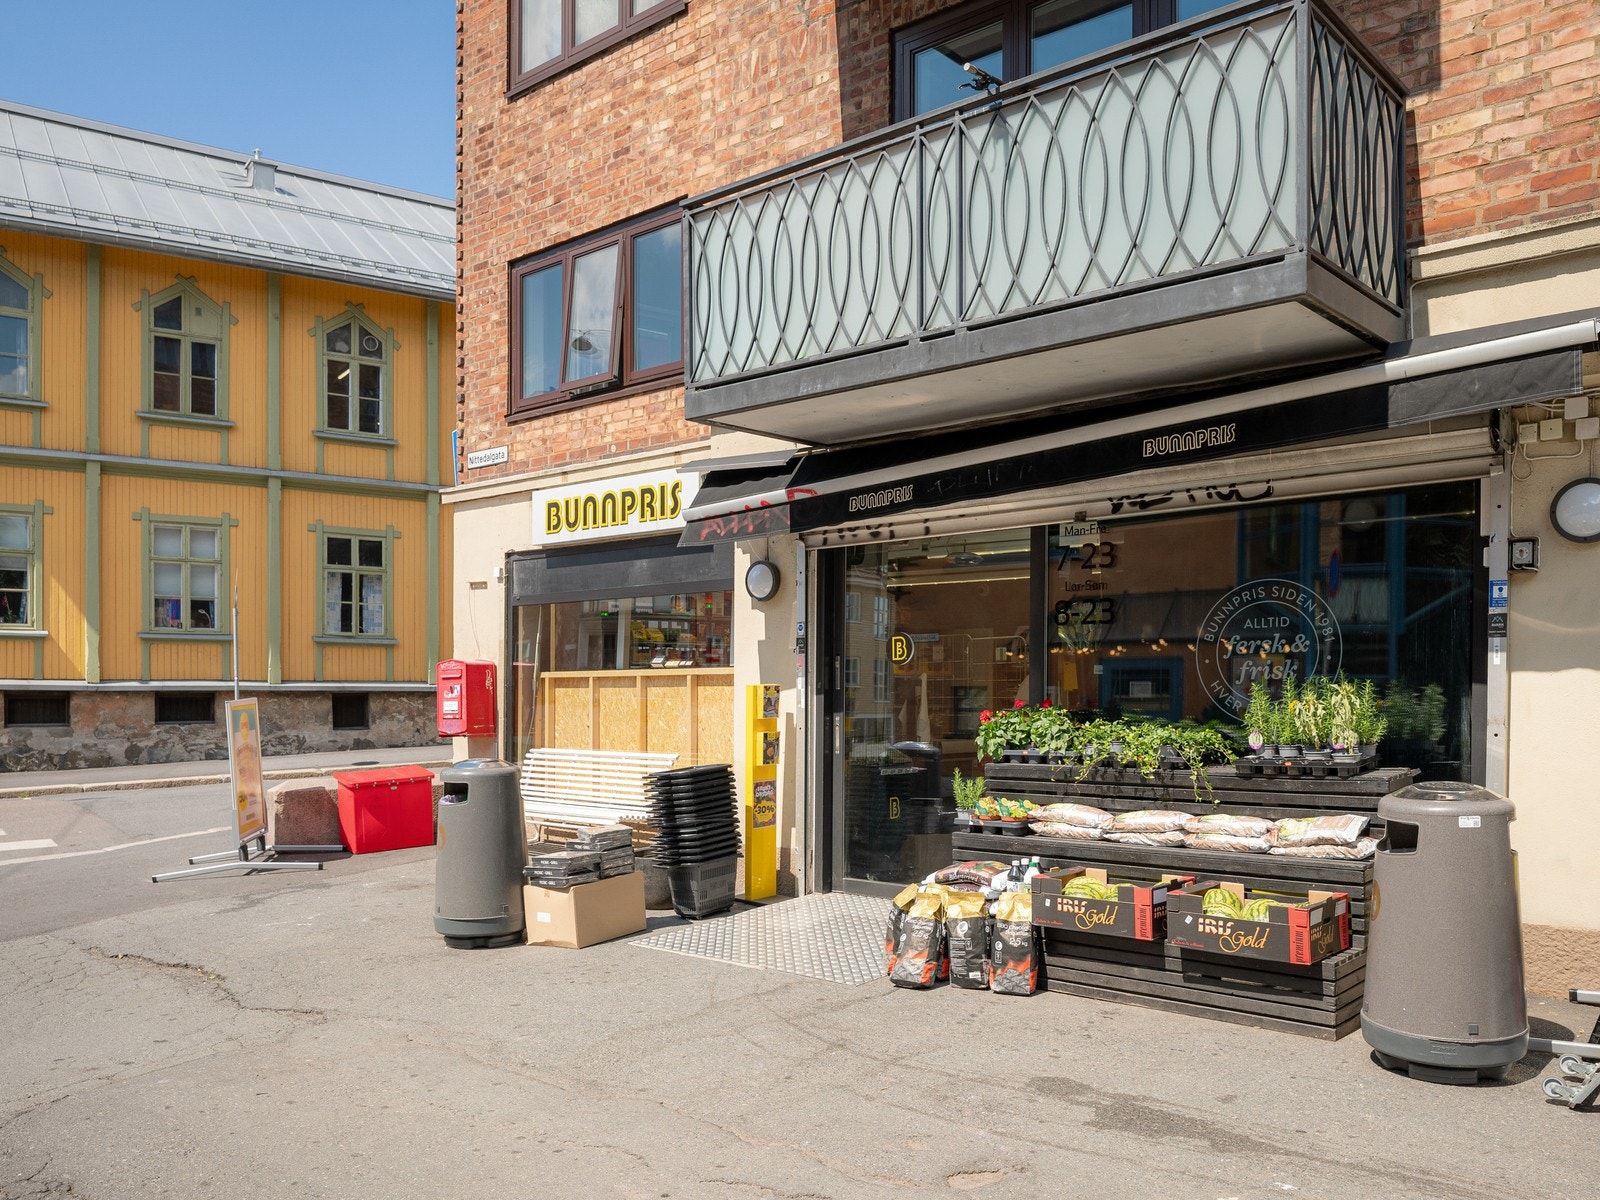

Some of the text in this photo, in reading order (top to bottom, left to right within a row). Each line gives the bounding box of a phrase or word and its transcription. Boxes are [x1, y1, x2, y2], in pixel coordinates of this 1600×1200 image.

[1142, 423, 1236, 457] BUNNPRIS
[469, 451, 505, 465] Nittedalgata
[545, 479, 682, 534] BUNNPRIS
[849, 484, 913, 512] BUNNPRIS
[1055, 541, 1116, 571] 7-23
[1054, 597, 1116, 626] 8-23
[1204, 585, 1336, 642] BUNNPRIS SIDEN 1981
[1243, 616, 1290, 629] ALLTID
[1223, 633, 1310, 659] fersk &
[1236, 659, 1298, 684] frisk
[1210, 680, 1243, 711] HVER
[755, 804, 775, 814] -30%
[1056, 897, 1087, 914] IRIS
[1075, 905, 1118, 930] Gold
[1138, 906, 1149, 938] premium
[1198, 917, 1234, 936] IRIS
[1219, 927, 1270, 953] Gold
[1293, 930, 1306, 963] premium
